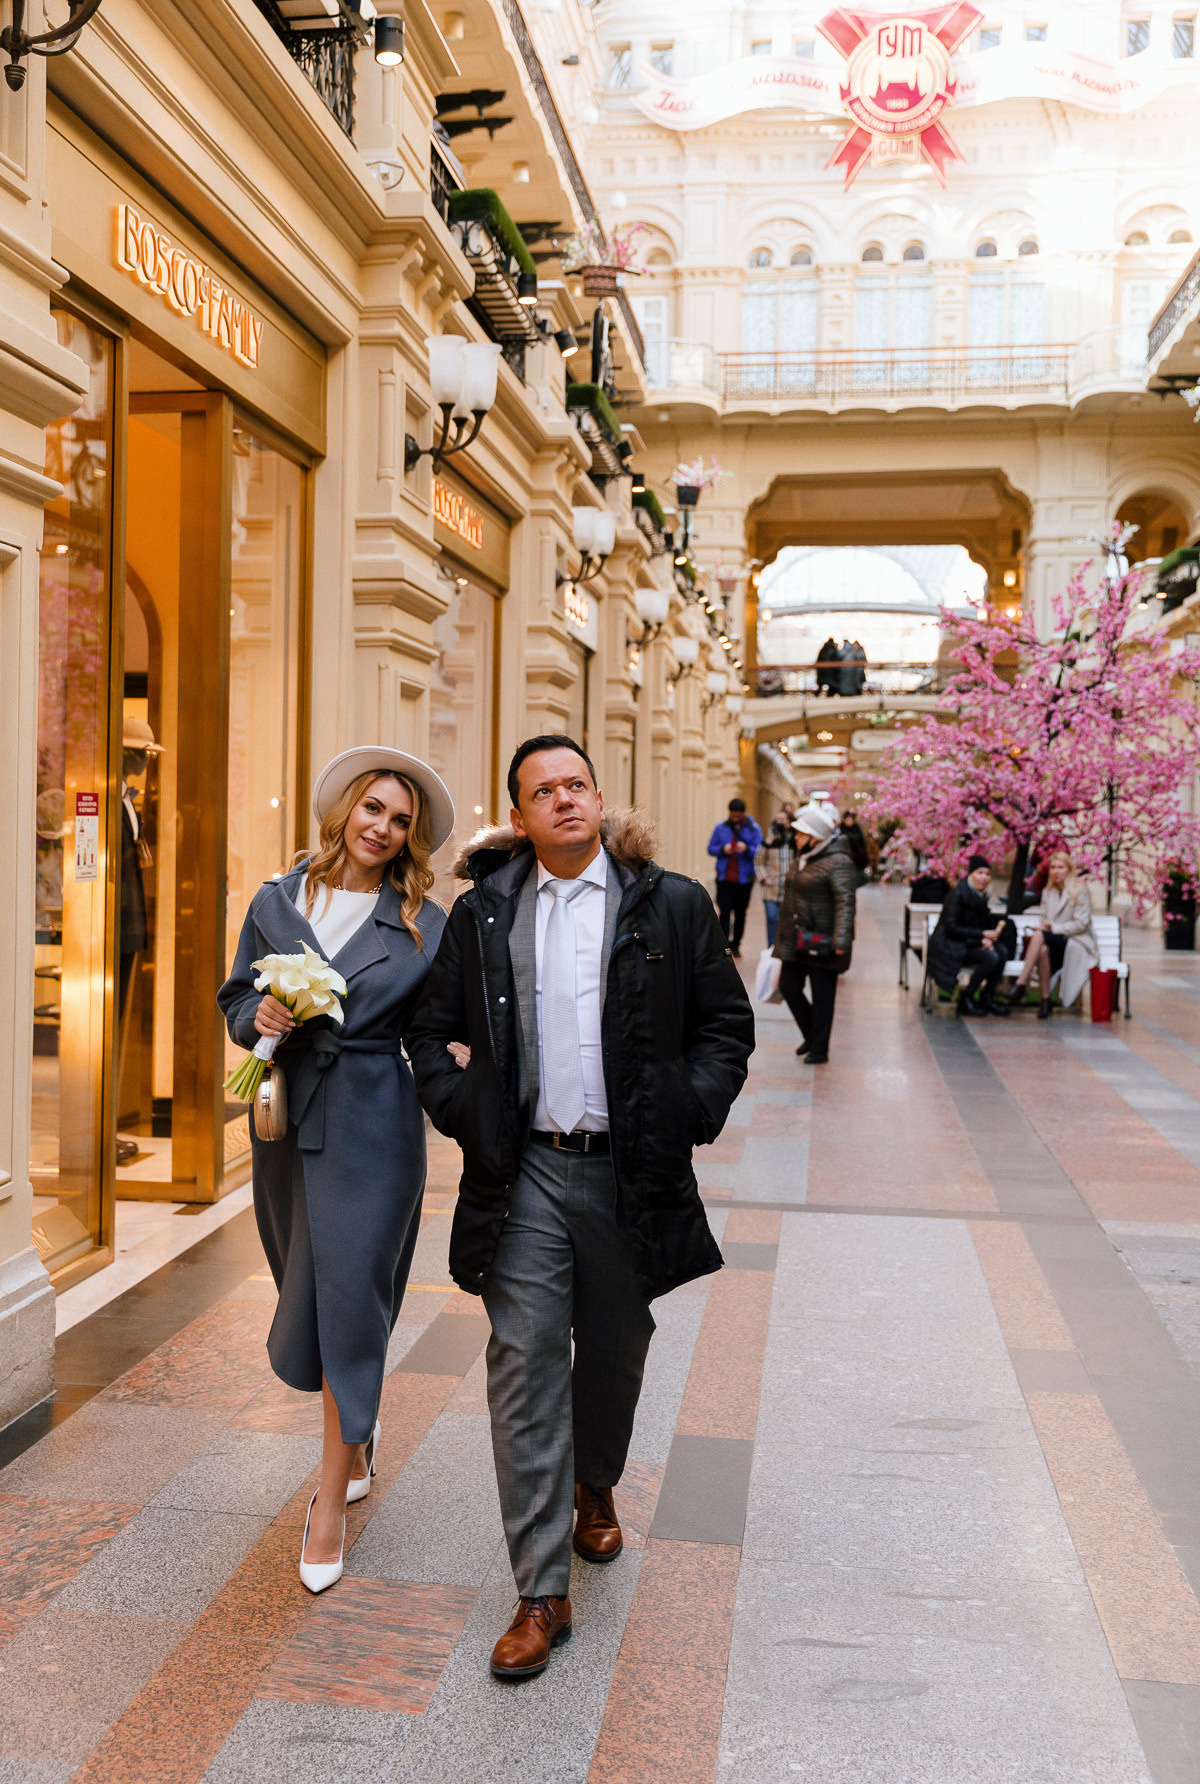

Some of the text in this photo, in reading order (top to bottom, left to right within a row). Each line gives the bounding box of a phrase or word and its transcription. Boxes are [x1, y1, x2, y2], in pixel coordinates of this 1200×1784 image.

[878, 25, 922, 58] ГУМ
[118, 203, 265, 369] BOSCO FAMILY
